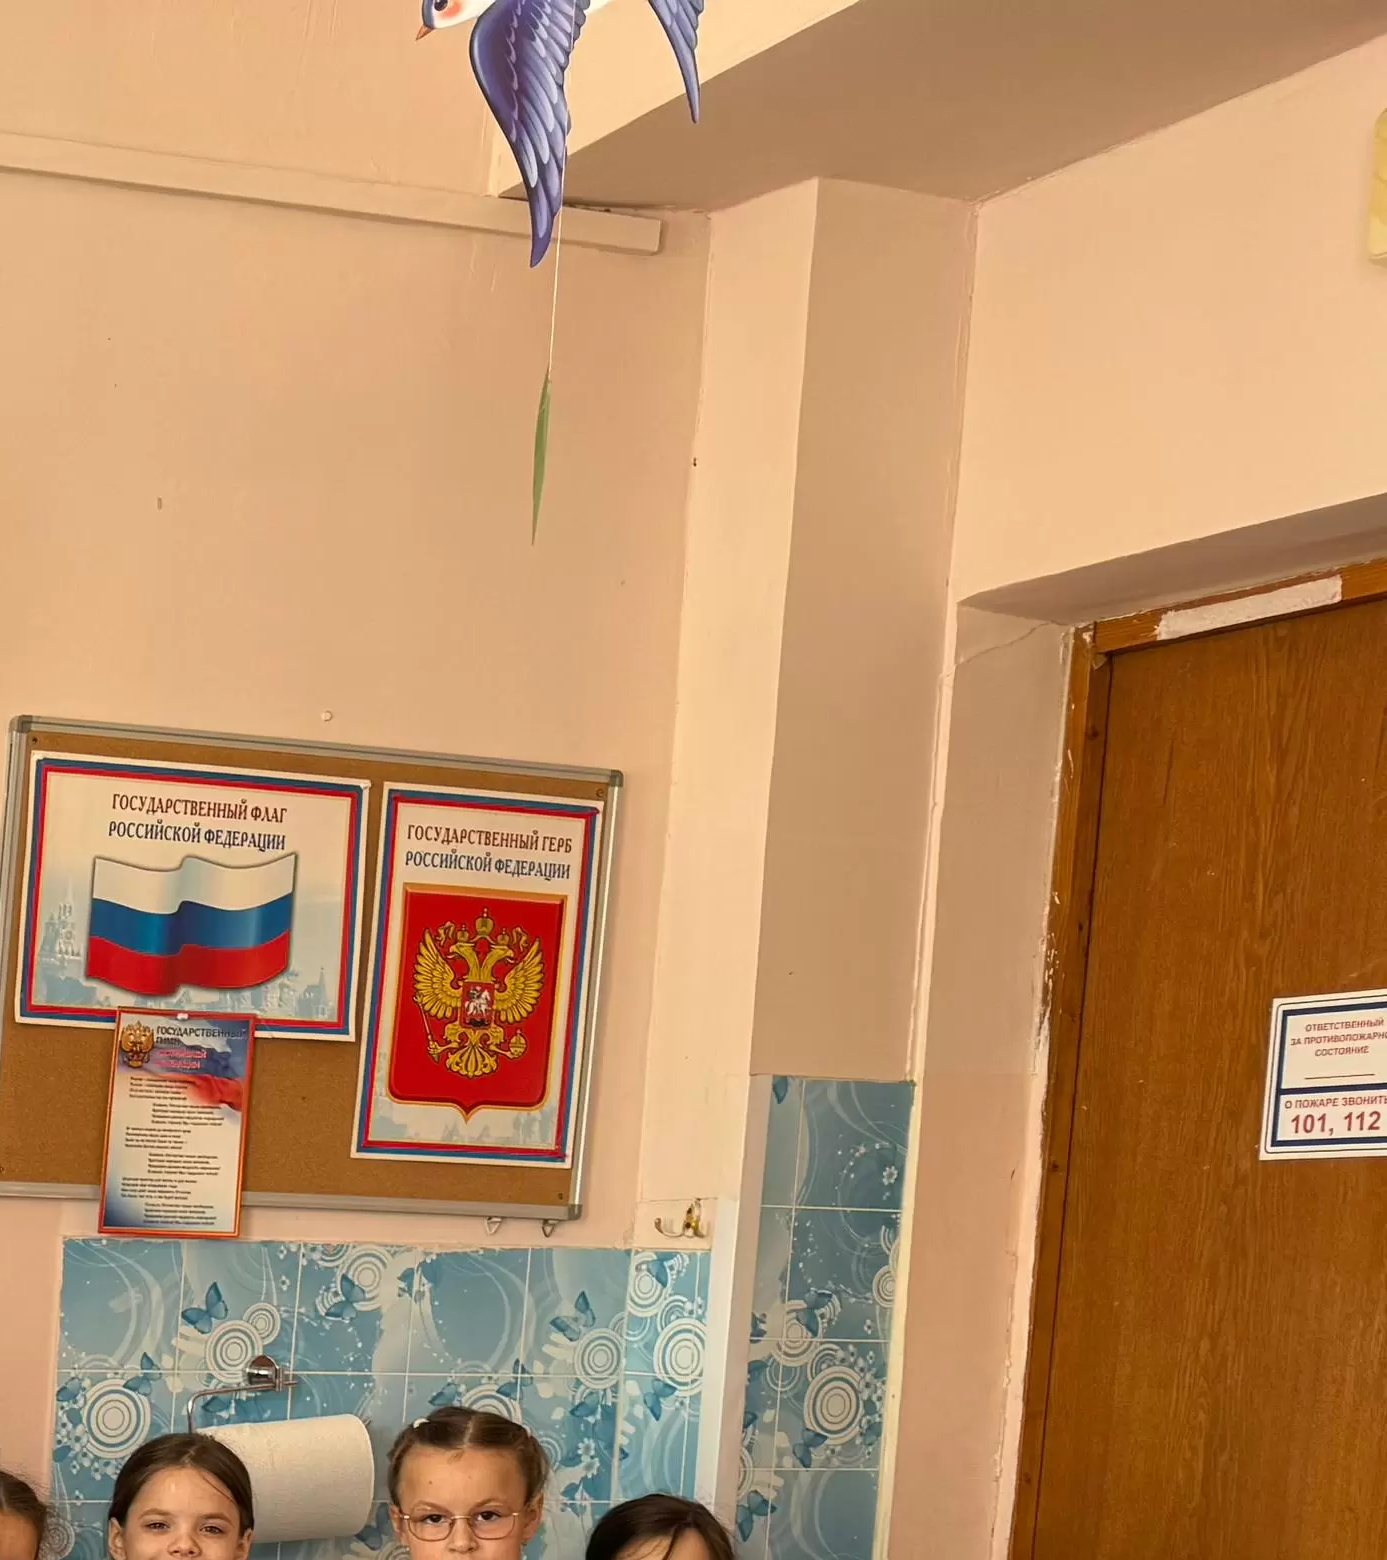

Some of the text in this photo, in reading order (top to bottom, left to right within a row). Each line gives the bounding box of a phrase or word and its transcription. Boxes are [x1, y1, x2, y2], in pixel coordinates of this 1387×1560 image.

[112, 793, 287, 823] ГОСУДАРСТВЕННЫЙ ФЛАГ
[108, 819, 286, 852] РОССИЙСКОЙ ФЕДЕРАЦИИ
[407, 824, 572, 854] ГОСУДАРСТВЕННЫЙ ГЕРБ
[405, 848, 571, 881] РОССИЙСКОЙ ФЕДЕРАЦИИ
[1305, 1017, 1384, 1032] ОТВЕТСТВЕННЫЙ
[1291, 1038, 1301, 1046] ЗА
[1315, 1046, 1369, 1056] СОСТОЯНИЕ
[1285, 1100, 1292, 1109] О
[1295, 1098, 1339, 1108] ПОЖАРЕ
[1291, 1111, 1381, 1136] 101, 112
